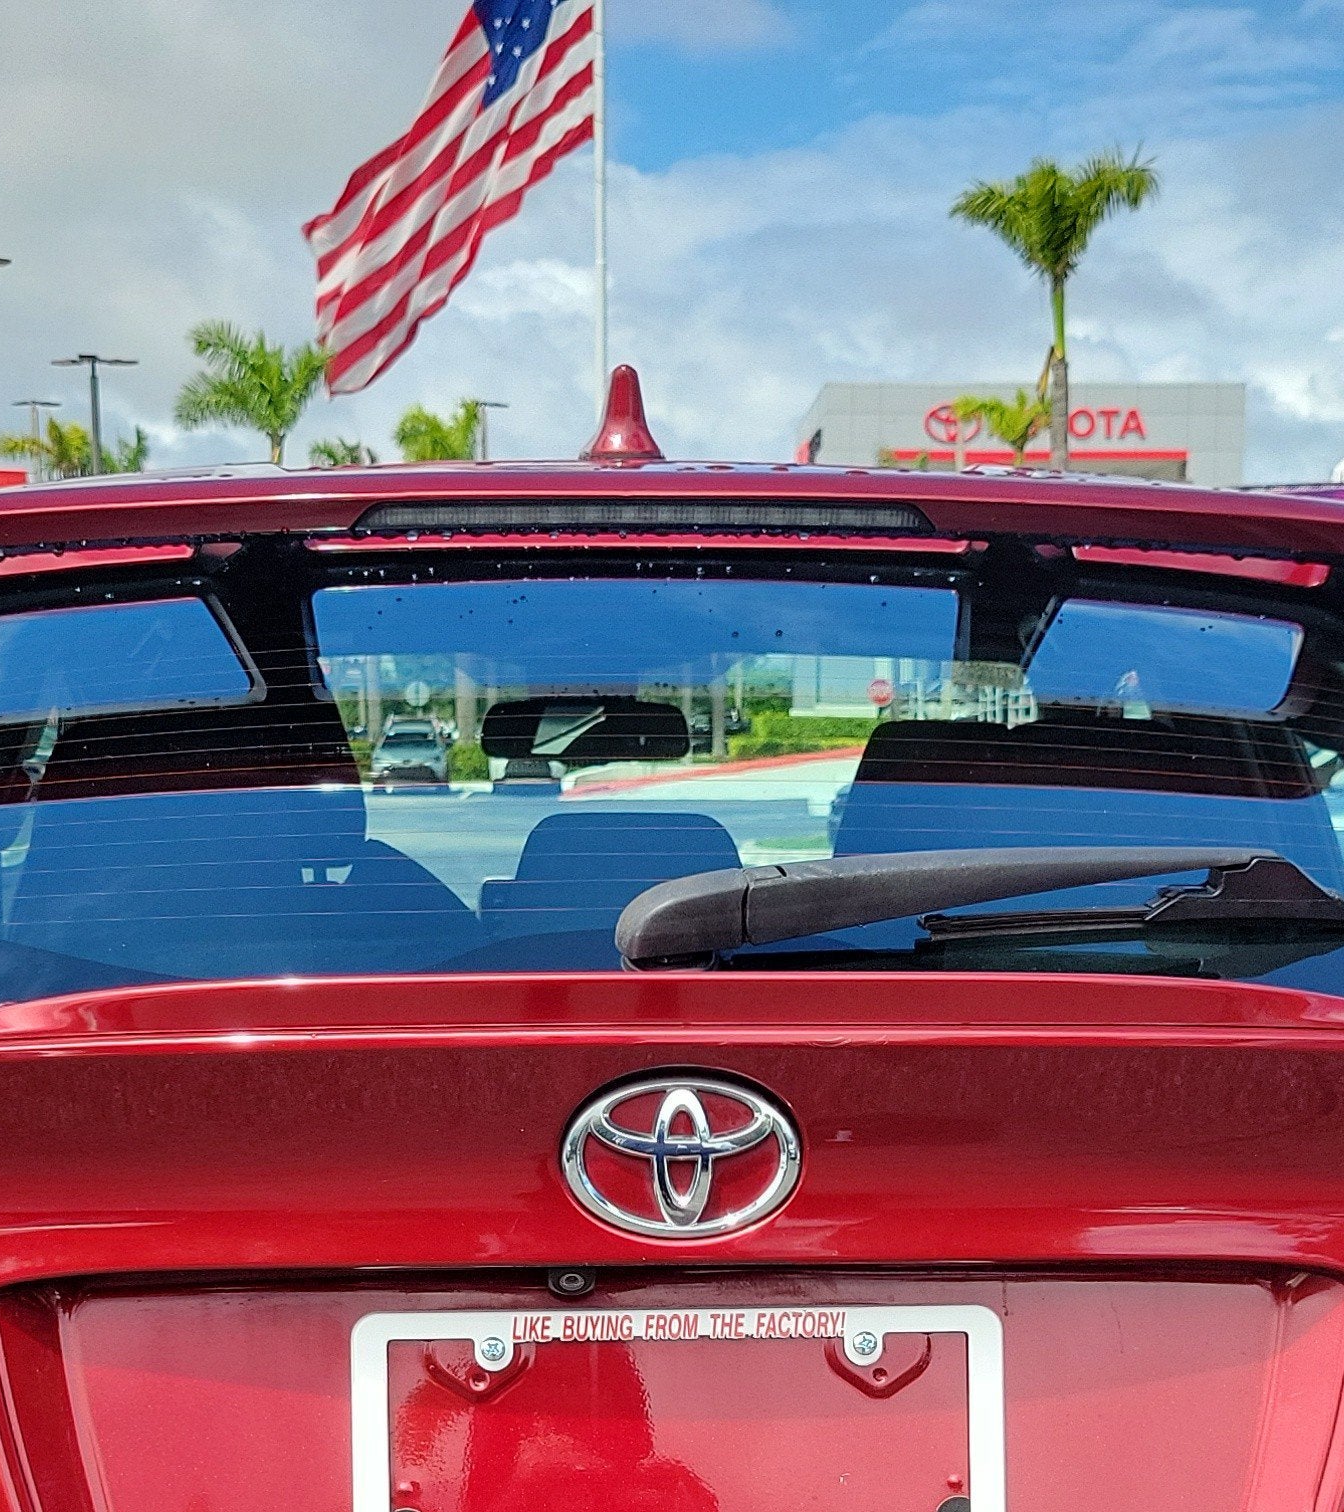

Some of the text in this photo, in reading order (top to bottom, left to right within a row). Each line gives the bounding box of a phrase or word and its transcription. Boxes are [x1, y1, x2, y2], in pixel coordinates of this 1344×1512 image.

[512, 1310, 846, 1341] LIKE BUYING FROM THE FACTORY!
